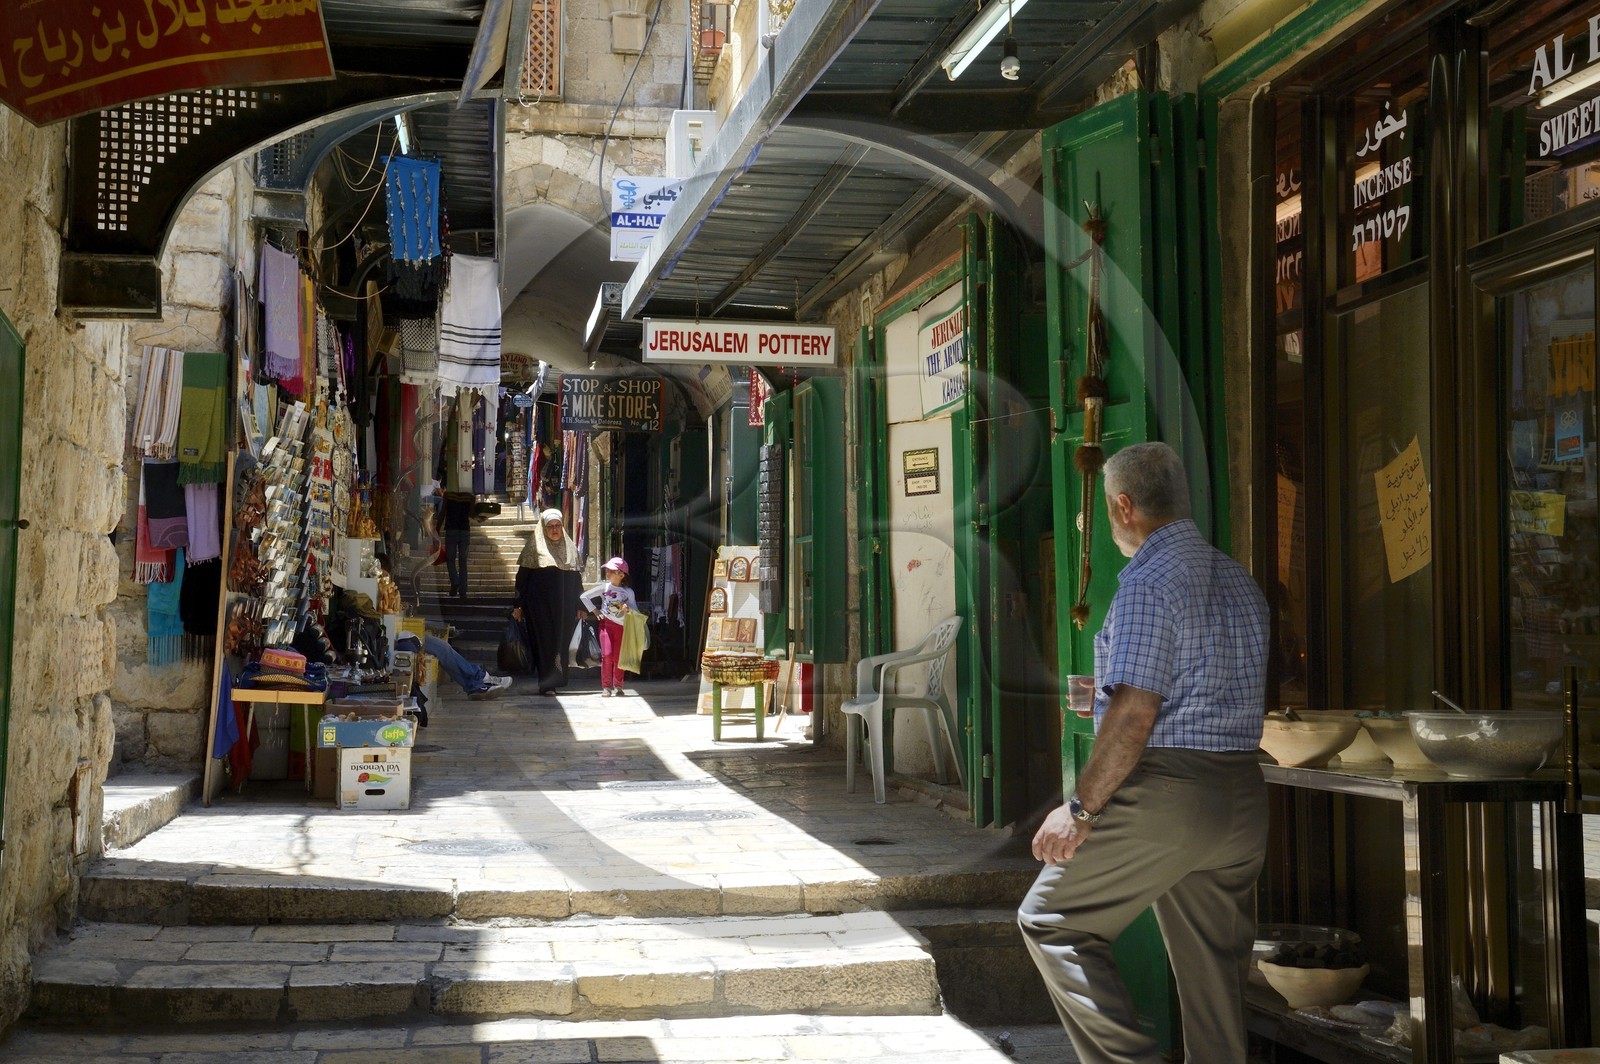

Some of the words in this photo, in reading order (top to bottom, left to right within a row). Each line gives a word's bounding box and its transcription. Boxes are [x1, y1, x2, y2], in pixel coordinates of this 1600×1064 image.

[12, 18, 84, 89] رباح
[91, 5, 132, 60] بن
[1527, 33, 1575, 96] AL
[1356, 100, 1408, 158] بخور
[1353, 156, 1412, 210] INCENSE
[1352, 204, 1411, 252] קטורת
[649, 330, 748, 354] JERUSALEM
[758, 333, 831, 356] POTTERY
[562, 378, 600, 393] STOP
[603, 383, 612, 393] &
[617, 379, 661, 394] SHOP
[572, 394, 604, 418] MIKE
[350, 764, 386, 772] Venosta
[386, 764, 400, 772] Val
